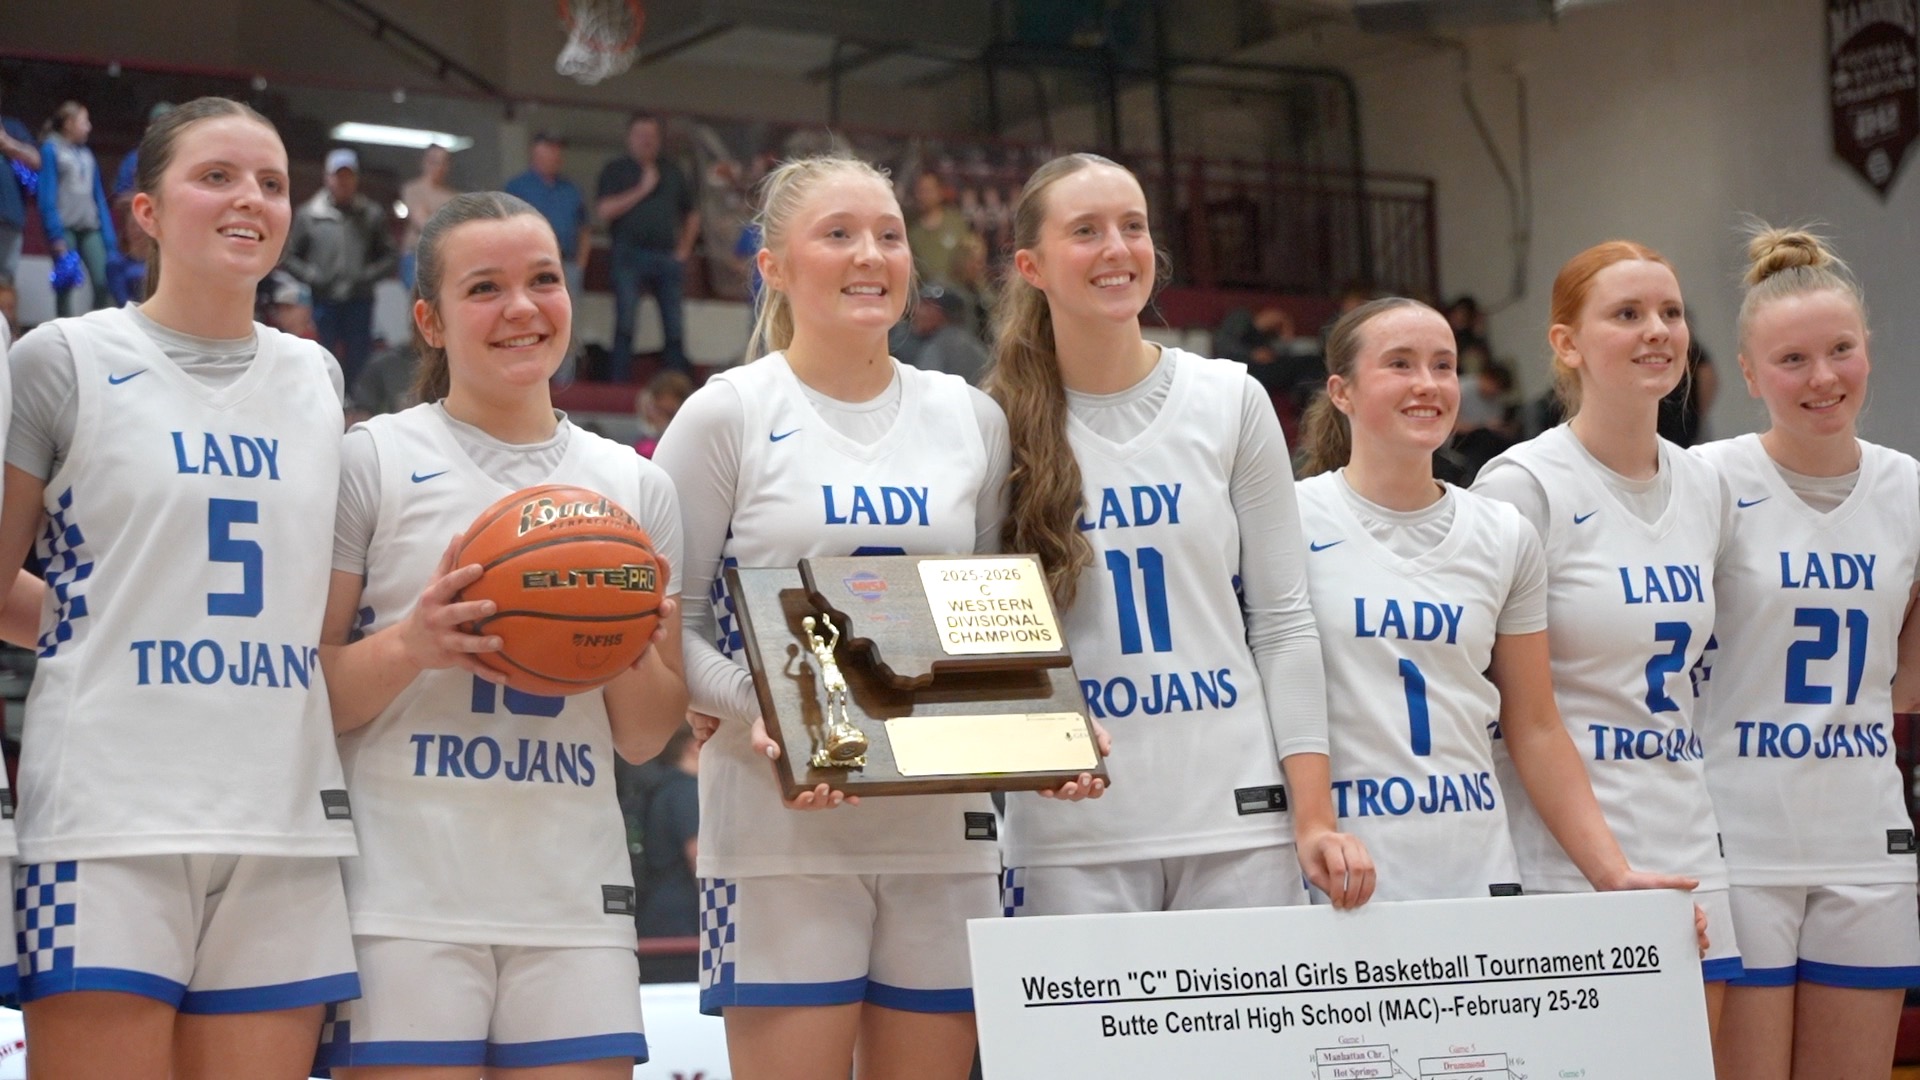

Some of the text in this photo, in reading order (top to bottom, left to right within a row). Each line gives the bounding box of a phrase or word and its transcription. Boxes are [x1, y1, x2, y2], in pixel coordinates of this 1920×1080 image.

[172, 431, 280, 479] LADY
[823, 485, 930, 526] LADY
[207, 497, 264, 616] 5
[941, 569, 1021, 581] 2025-2026
[1780, 550, 1877, 591] LADY
[948, 598, 1033, 612] WESTERN
[980, 584, 991, 596] C
[1105, 546, 1173, 655] 11
[1618, 564, 1705, 605] LADY
[584, 633, 624, 647] NFHS
[947, 614, 1044, 628] DIVISIONAL
[949, 629, 1052, 644] CHAMPIONS
[1355, 597, 1463, 644] LADY
[1645, 621, 1692, 714] 2
[1784, 607, 1870, 706] 21
[1079, 667, 1238, 718] ROJANS
[1398, 657, 1432, 757] 1
[410, 734, 595, 788] TROJANS
[1735, 721, 1890, 760] TROJANS
[1274, 792, 1281, 804] S
[1332, 772, 1496, 818] TROJANS
[1022, 945, 1660, 1000] Western "C" Divisional Girls Basketball Tournament 2026
[1101, 1014, 1158, 1037] Butte
[1165, 1008, 1240, 1034] Central
[1247, 1006, 1295, 1034] High
[1302, 1001, 1372, 1026] School
[1548, 988, 1600, 1011] 25-28
[1323, 1052, 1365, 1062] Manhattan
[1366, 1050, 1385, 1060] Chr.
[1443, 1060, 1486, 1070] Drummond
[1448, 1045, 1470, 1054] Game
[1333, 1067, 1379, 1079] Hot Springs
[1558, 1069, 1579, 1079] Game
